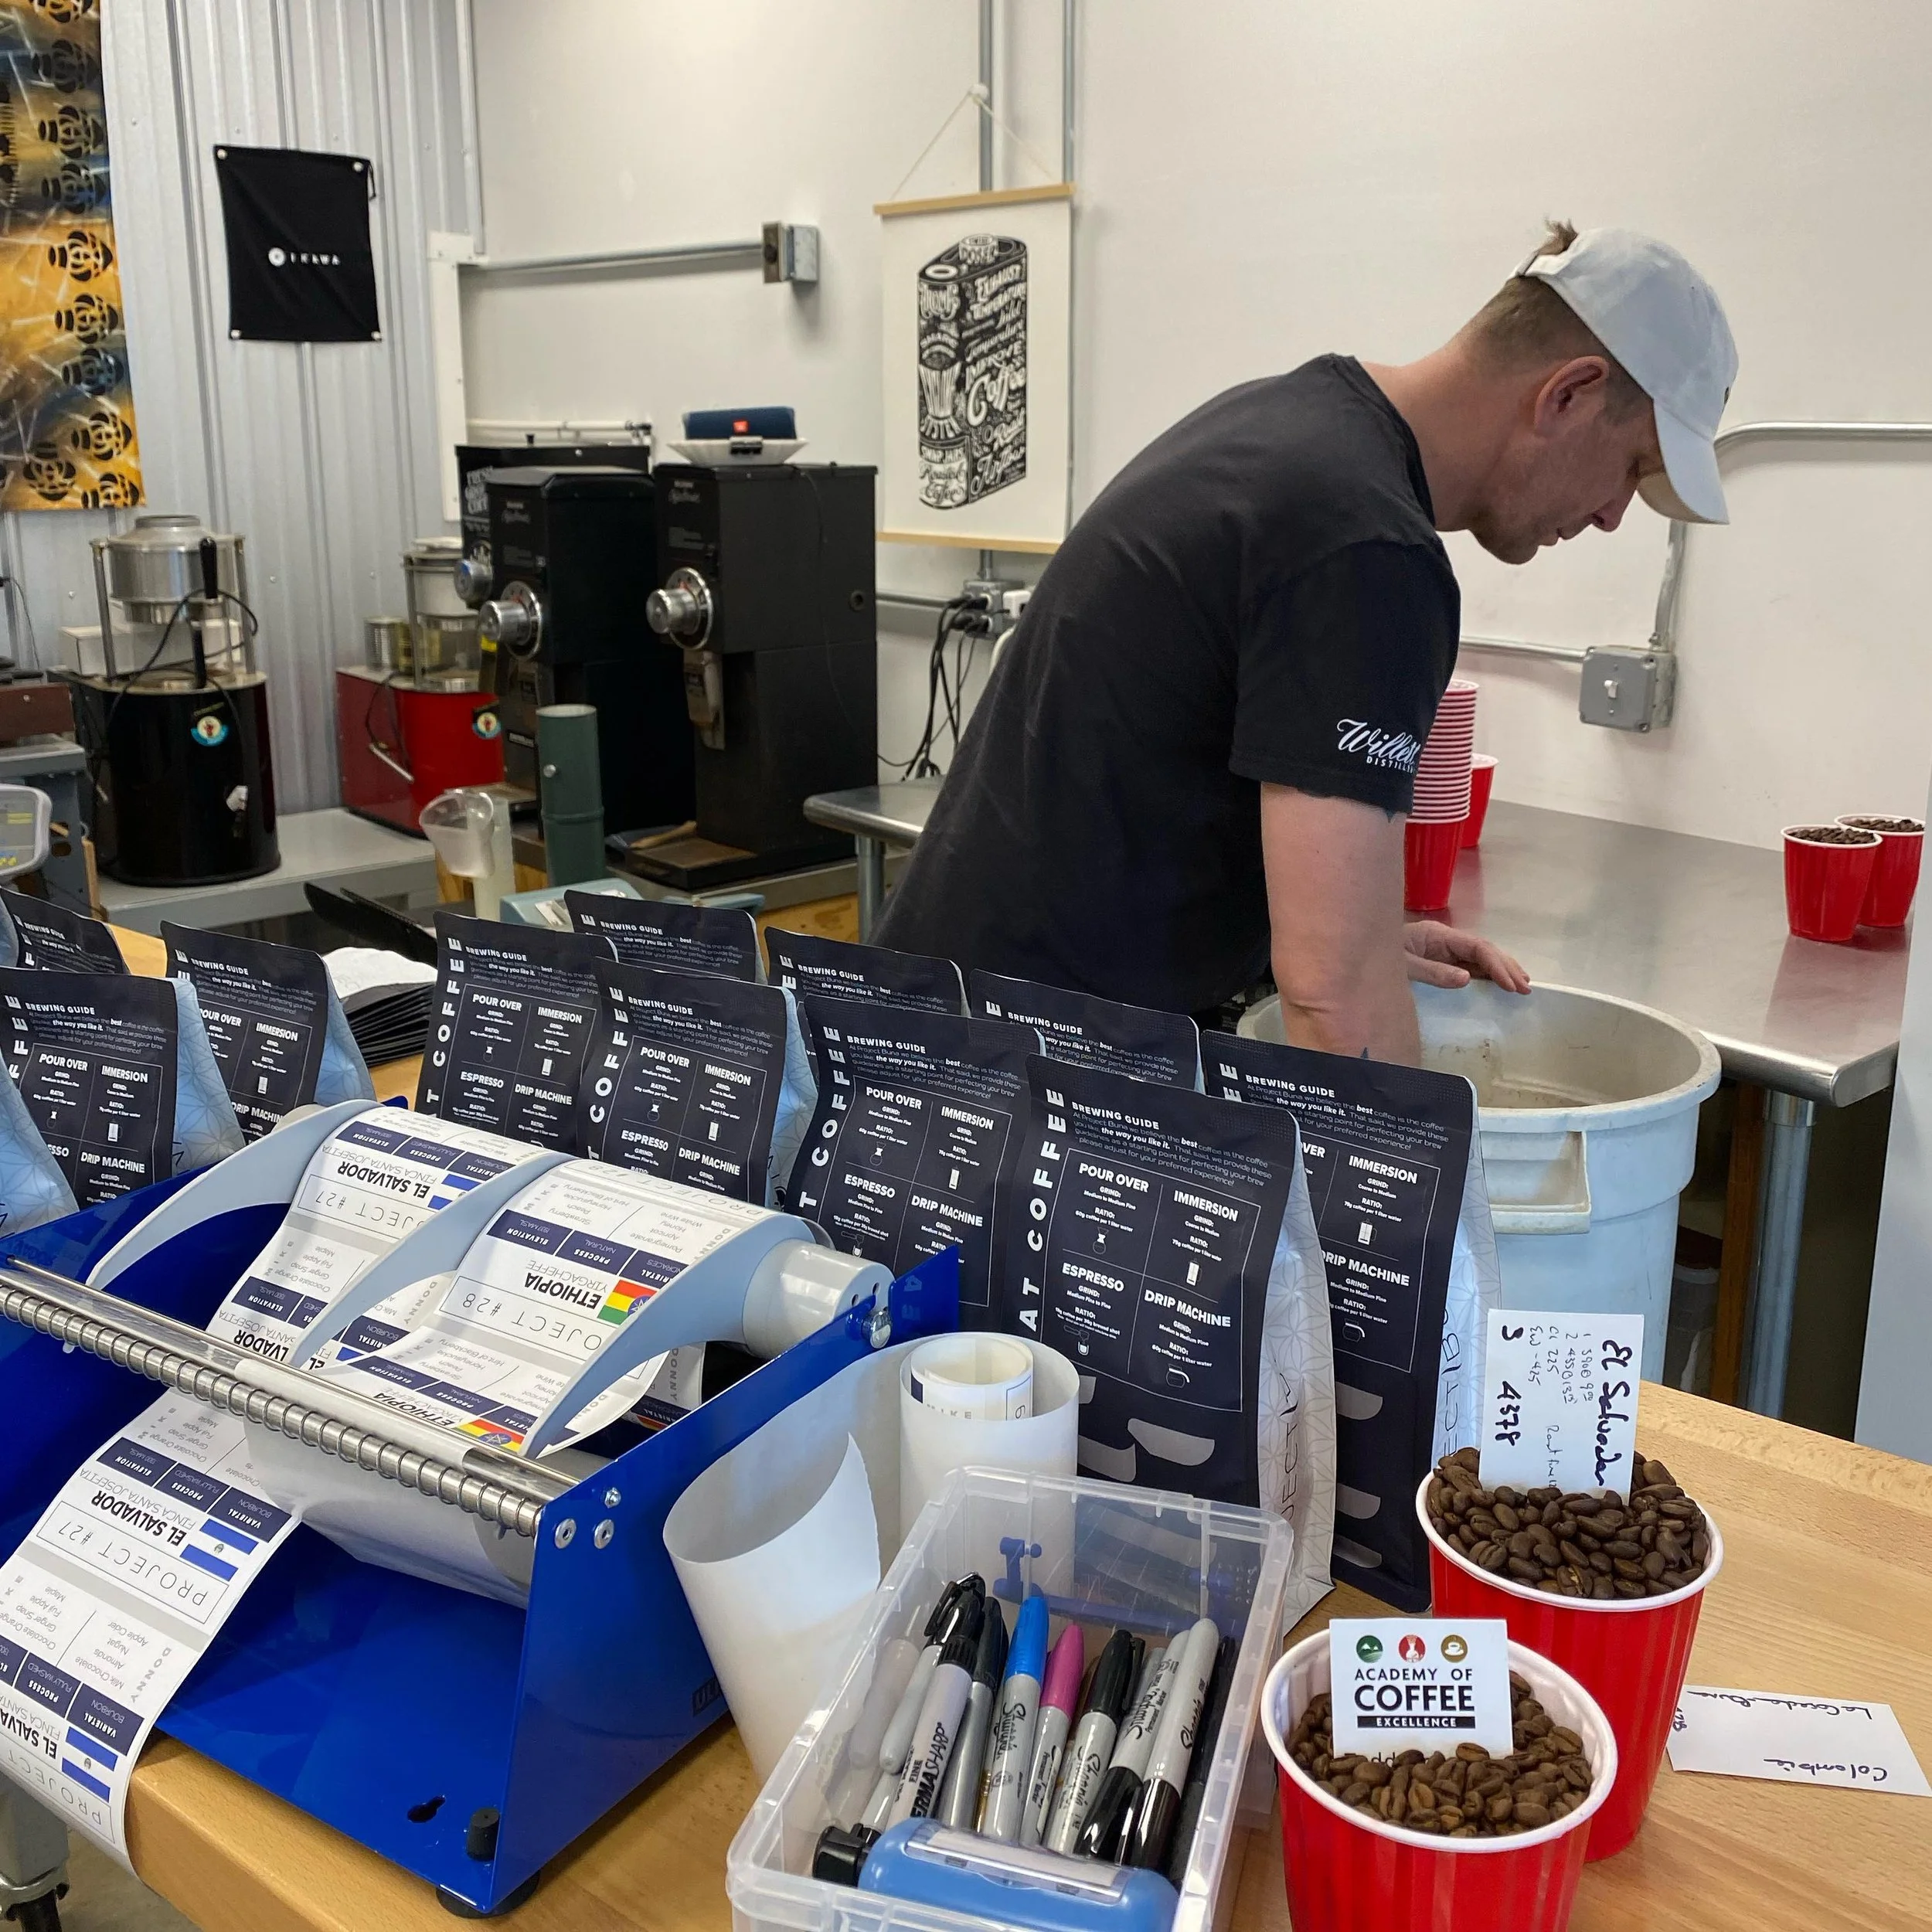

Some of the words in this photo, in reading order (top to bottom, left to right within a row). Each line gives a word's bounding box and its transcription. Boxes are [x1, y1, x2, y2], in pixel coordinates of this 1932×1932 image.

[600, 921, 637, 930] BREWING
[639, 925, 663, 935] GUIDE
[465, 946, 501, 957] BREWING
[502, 952, 527, 961] GUIDE
[191, 958, 225, 971] BREWING
[226, 965, 249, 976] GUIDE
[798, 964, 836, 976] BREWING
[839, 970, 864, 981] GUIDE
[25, 1002, 65, 1013] BREWING
[68, 1006, 95, 1015] GUIDE
[473, 994, 498, 1006] POUR
[499, 999, 522, 1012] OVER
[628, 996, 665, 1009] BREWING
[668, 1004, 693, 1015] GUIDE
[220, 1014, 242, 1027] OVER
[538, 1006, 582, 1024] IMMERSION
[1008, 1012, 1050, 1028] BREWING
[1053, 1021, 1083, 1035] GUIDE
[256, 1022, 298, 1042] IMMERSION
[847, 1036, 893, 1048] BREWING
[896, 1042, 926, 1053] GUIDE
[39, 1053, 66, 1067] POUR
[66, 1058, 87, 1071] OVER
[641, 1047, 665, 1061] POUR
[667, 1053, 689, 1067] OVER
[945, 1058, 961, 1067] best
[101, 1065, 148, 1083] IMMERSION
[461, 1071, 504, 1088] ESPRESSO
[705, 1063, 751, 1086] IMMERSION
[515, 1083, 534, 1097] DRIP
[535, 1088, 573, 1105] MACHINE
[1246, 1074, 1296, 1091] BREWING
[1300, 1083, 1335, 1098] GUIDE
[866, 1087, 894, 1102] POUR
[896, 1094, 922, 1110] OVER
[251, 1107, 284, 1123] MACHIN
[941, 1106, 994, 1131] IMMERSION
[1072, 1101, 1122, 1121] BREWING
[1124, 1113, 1159, 1130] GUIDE
[1277, 1097, 1289, 1106] the
[1290, 1100, 1306, 1110] way
[1308, 1104, 1322, 1112] you
[1324, 1105, 1337, 1115] like
[1427, 1131, 1449, 1142] these
[1356, 1104, 1372, 1115] best
[1420, 1120, 1444, 1132] coffee
[876, 1124, 893, 1134] RATIO:
[1102, 1127, 1114, 1136] the
[1115, 1130, 1131, 1141] way
[1133, 1134, 1147, 1144] you
[1148, 1135, 1162, 1147] like
[352, 1133, 389, 1147] ELEVATION
[621, 1130, 668, 1151] ESPRESSO
[1182, 1138, 1198, 1148] best
[1424, 1138, 1442, 1150] brew
[80, 1152, 100, 1165] DRIP
[102, 1157, 145, 1173] MACHINE
[410, 1149, 441, 1162] PROCESS
[679, 1148, 700, 1162] DRIP
[701, 1154, 740, 1175] MACHINE
[338, 1161, 412, 1193] SALVADOR
[1079, 1162, 1114, 1182] POUR
[1115, 1172, 1149, 1193] OVER
[1349, 1155, 1417, 1184] IMMERSION
[413, 1182, 430, 1199] EL
[845, 1174, 896, 1198] ESPRESSO
[1100, 1185, 1121, 1198] GRIND:
[1368, 1178, 1389, 1189] GRIND:
[316, 1191, 346, 1209] #27
[1174, 1190, 1238, 1222] IMMERSION
[1362, 1197, 1383, 1209] RATIO:
[911, 1195, 938, 1212] DRIP
[940, 1203, 983, 1227] MACHINE
[1095, 1206, 1116, 1219] RATIO:
[506, 1226, 549, 1245] ELEVATION
[574, 1248, 612, 1265] PROCESS
[526, 1259, 609, 1293] YIRGACHEFFE
[1062, 1263, 1124, 1291] ESPRESSO
[1349, 1259, 1410, 1287] MACHINE
[524, 1272, 602, 1310] ETHIOPIA
[1078, 1285, 1100, 1298] GRIND:
[248, 1294, 284, 1312] ELEVATION
[462, 1292, 502, 1316] #28
[1075, 1307, 1096, 1319] RATIO:
[1144, 1289, 1175, 1308] DRIP
[1177, 1300, 1231, 1328] MACHINE
[114, 1455, 153, 1476] ELEVATION
[79, 1468, 130, 1496] JOSEFITA
[171, 1482, 204, 1501] PROCESS
[91, 1490, 168, 1536] SALVADOR
[128, 1492, 164, 1514] SANTA
[163, 1509, 196, 1530] FINCA
[228, 1509, 262, 1529] VARIETAL
[58, 1519, 94, 1547] #27
[166, 1529, 187, 1546] EL
[98, 1541, 209, 1606] PROJECT
[107, 1640, 129, 1656] Nugat
[94, 1649, 124, 1670] Almonds
[75, 1656, 110, 1684] Chocolate
[1355, 1668, 1438, 1681] ACADEMY
[1451, 1668, 1473, 1681] OF
[29, 1680, 59, 1702] PROCESS
[1354, 1685, 1475, 1712] COFFEE
[91, 1699, 125, 1724] BOURBON
[84, 1712, 117, 1738] VARIETAL
[1376, 1717, 1457, 1727] EXCELLENCE
[44, 1740, 57, 1760] EL
[909, 1760, 923, 1783] FINE
[8, 1749, 101, 1826] PROJECT
